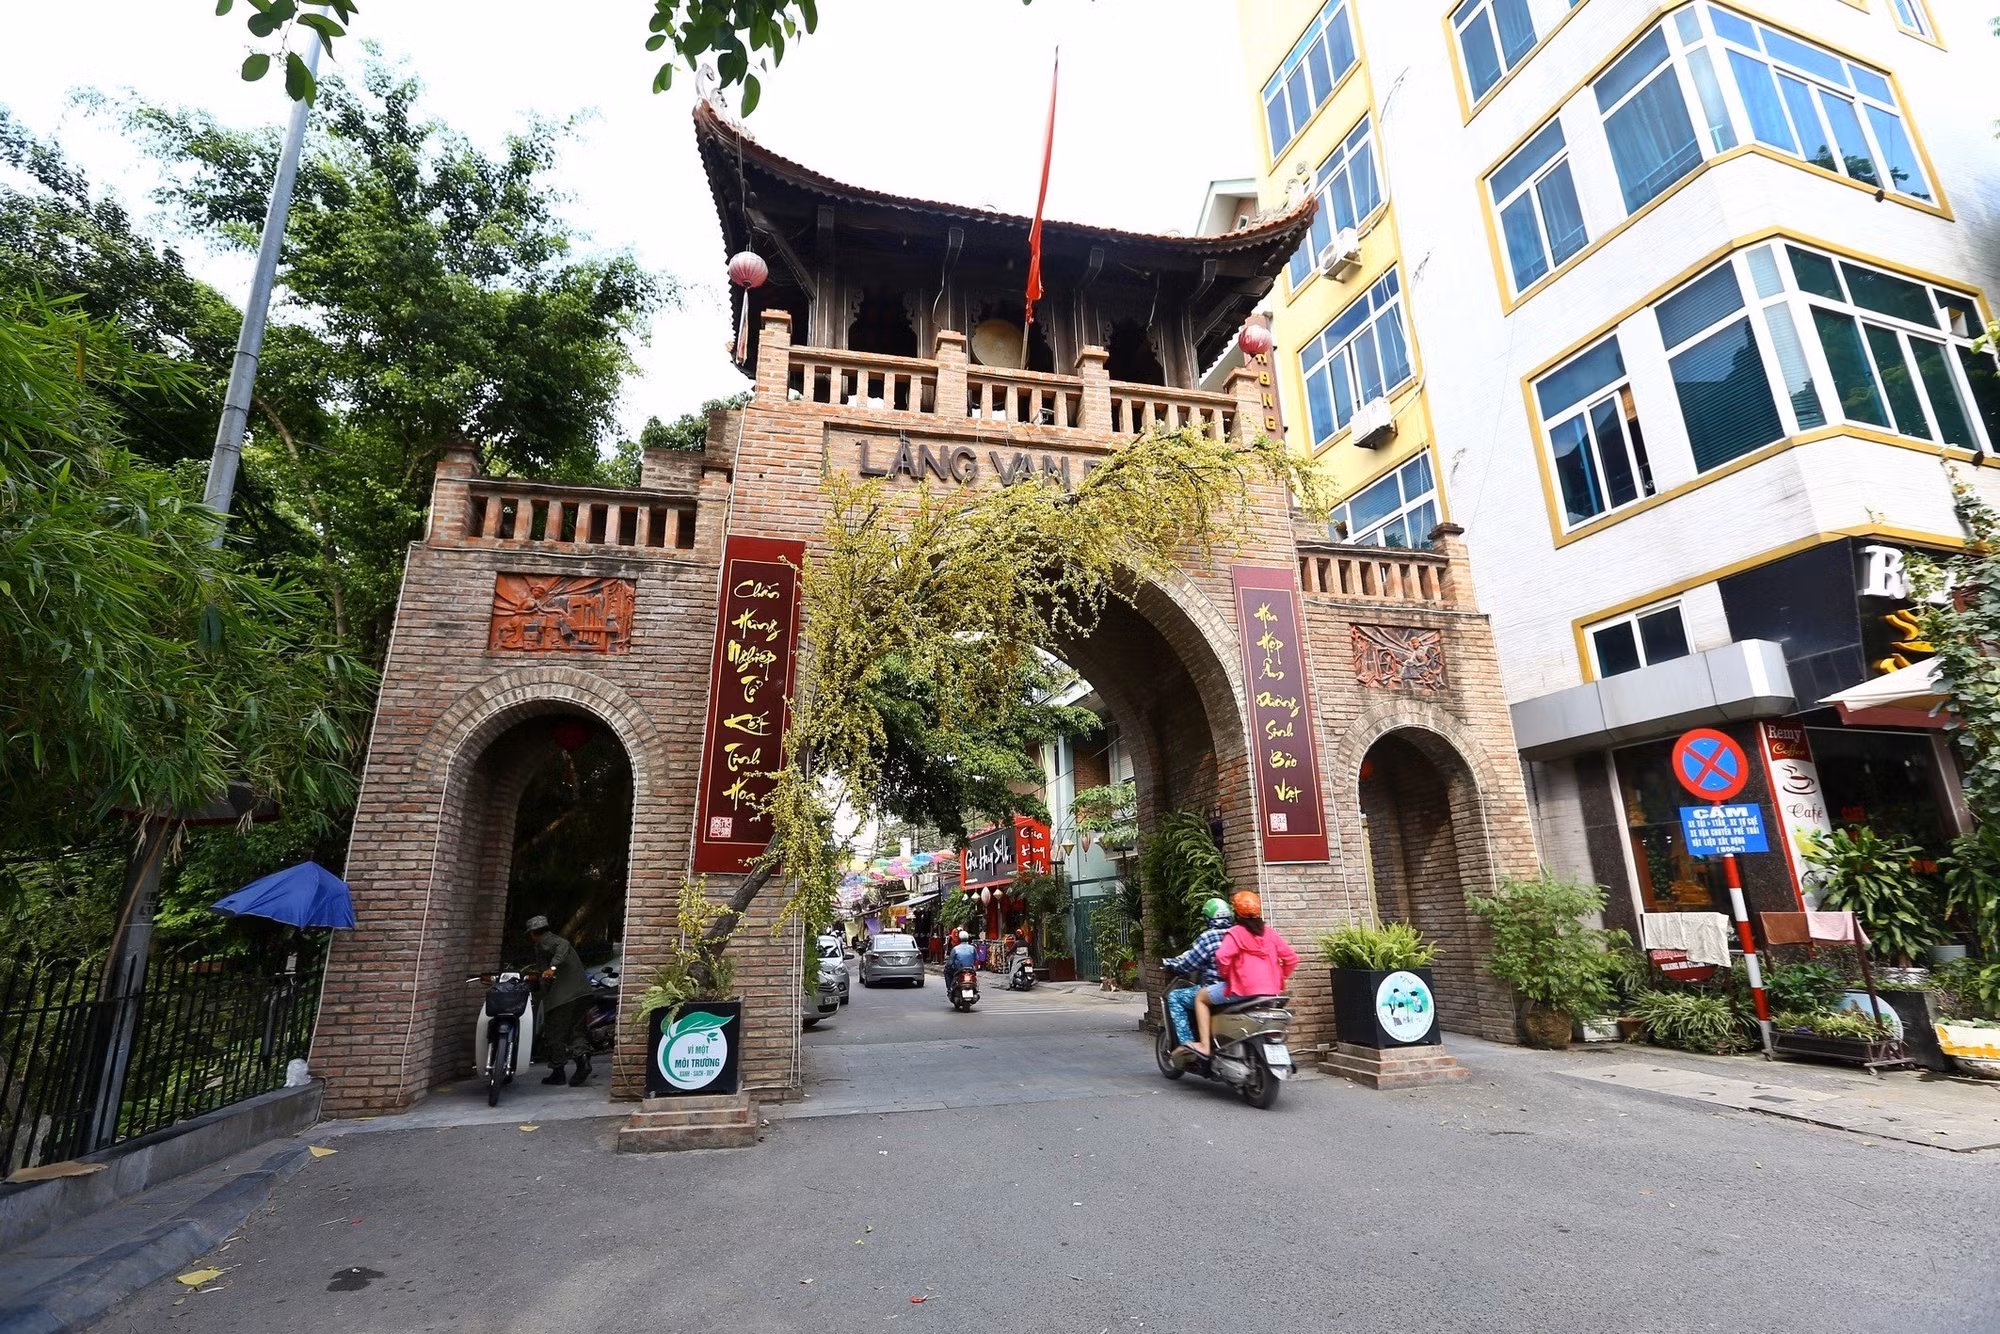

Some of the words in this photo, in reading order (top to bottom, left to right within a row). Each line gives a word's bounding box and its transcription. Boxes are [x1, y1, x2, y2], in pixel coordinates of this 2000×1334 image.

[1265, 719, 1294, 740] Sinh
[1767, 725, 1801, 743] Remy
[724, 743, 761, 772] Tinh
[1772, 742, 1805, 757] Coffee
[722, 777, 756, 811] Hoa
[1693, 805, 1749, 819] CẤM
[1786, 803, 1823, 825] Café
